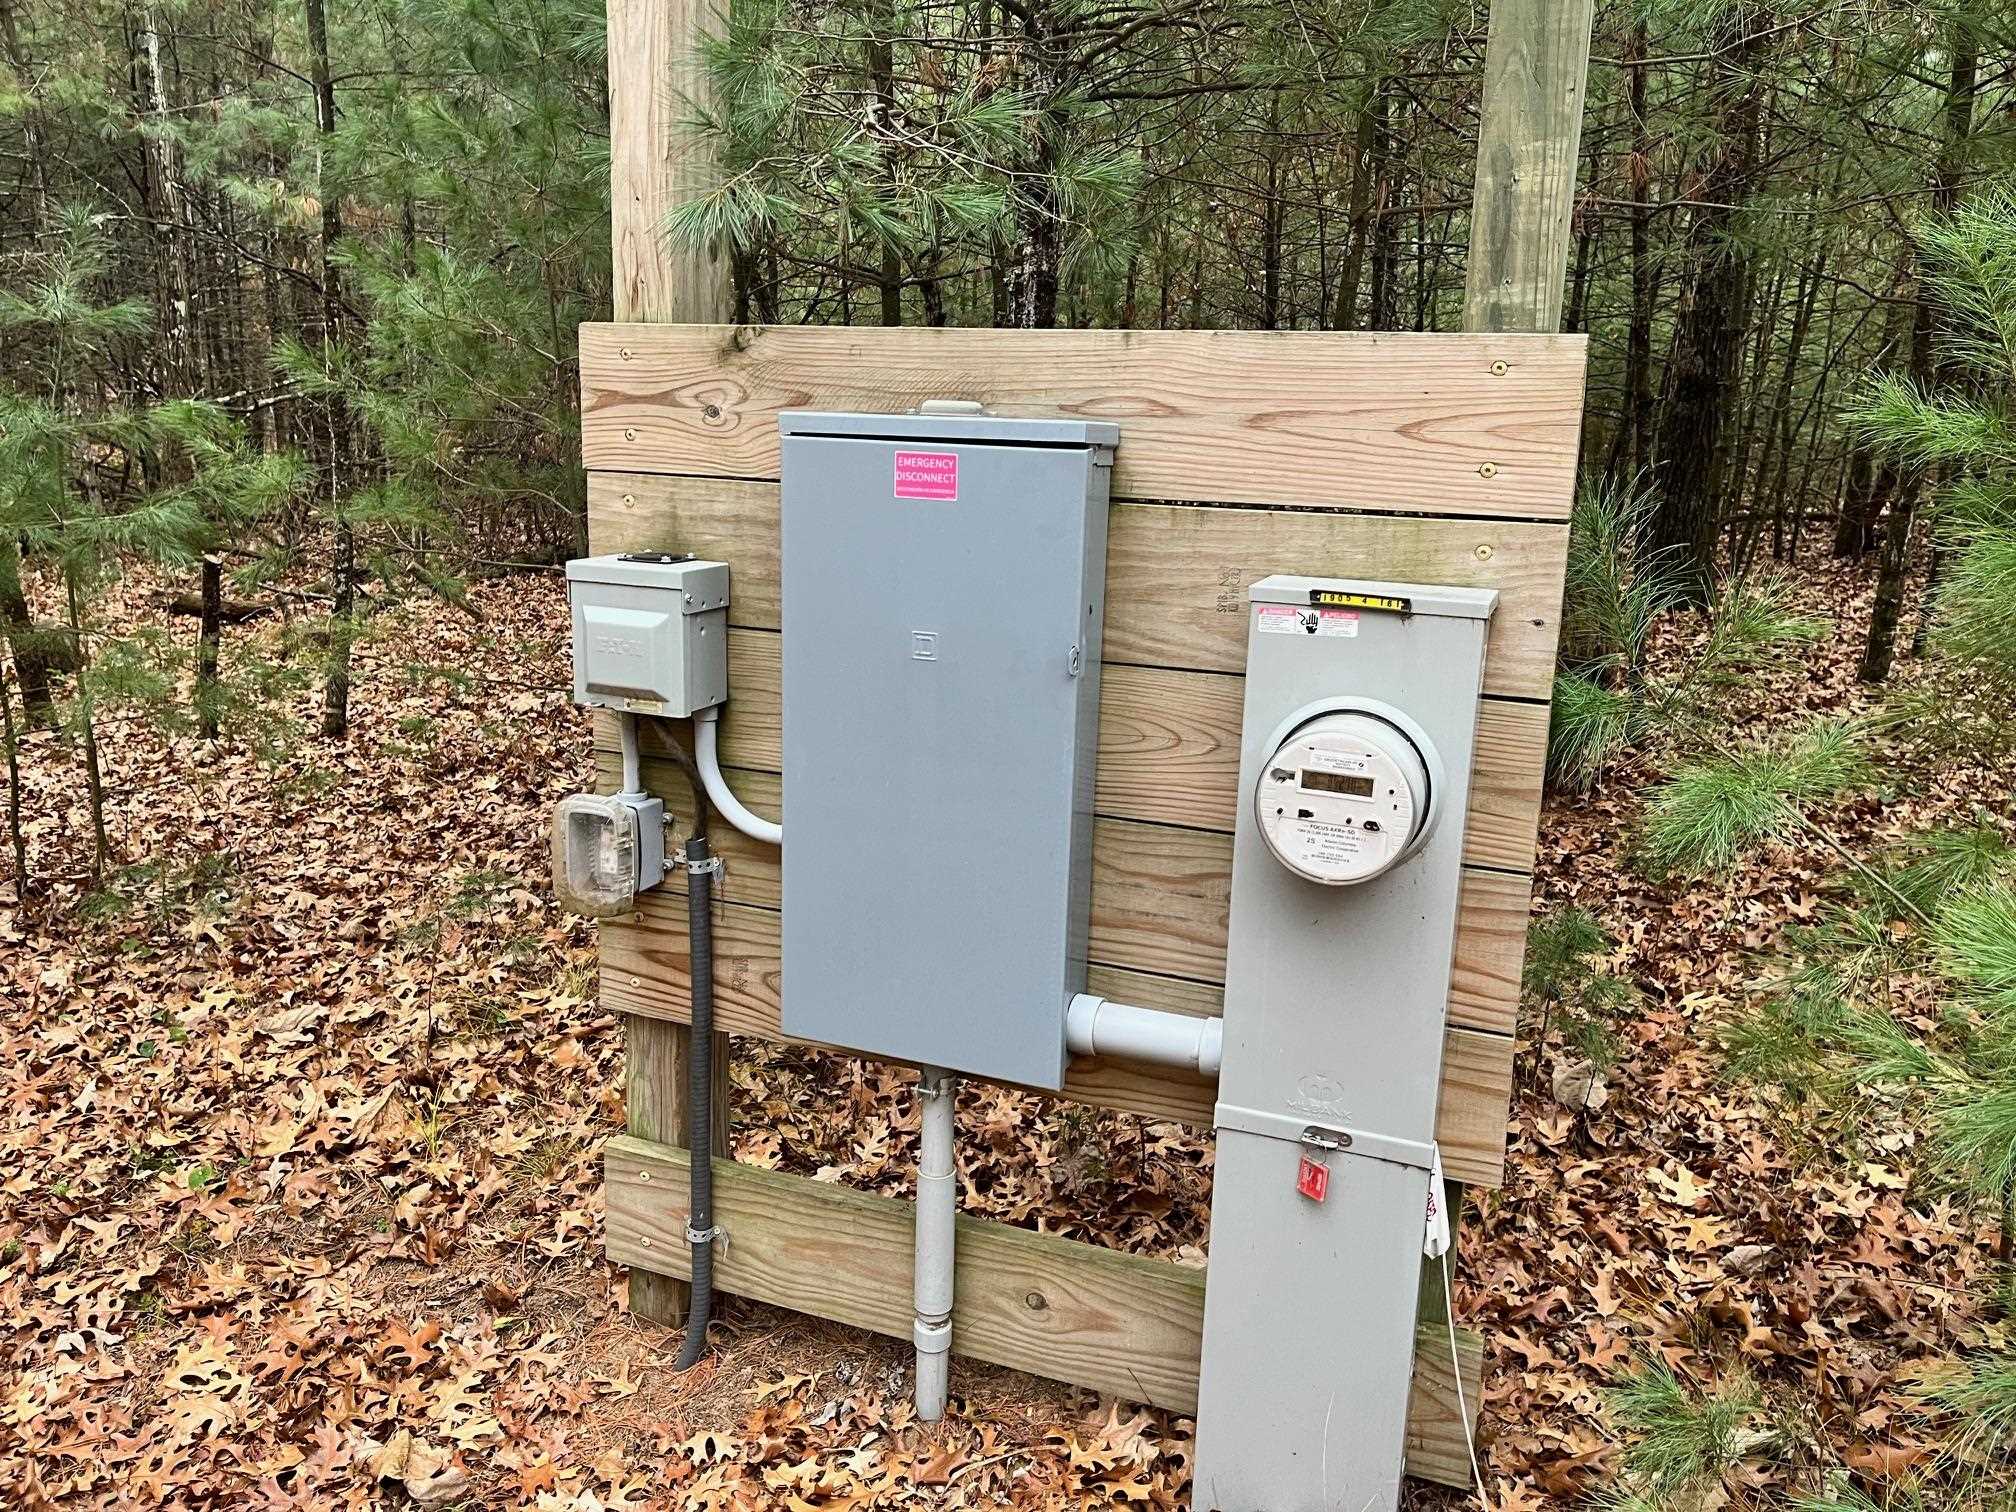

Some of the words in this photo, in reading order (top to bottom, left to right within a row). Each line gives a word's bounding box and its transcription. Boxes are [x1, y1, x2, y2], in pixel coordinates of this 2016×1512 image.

[898, 456, 954, 469] EMERGENCY
[896, 470, 956, 484] DISCONNECT
[1310, 824, 1329, 832] FOCUS
